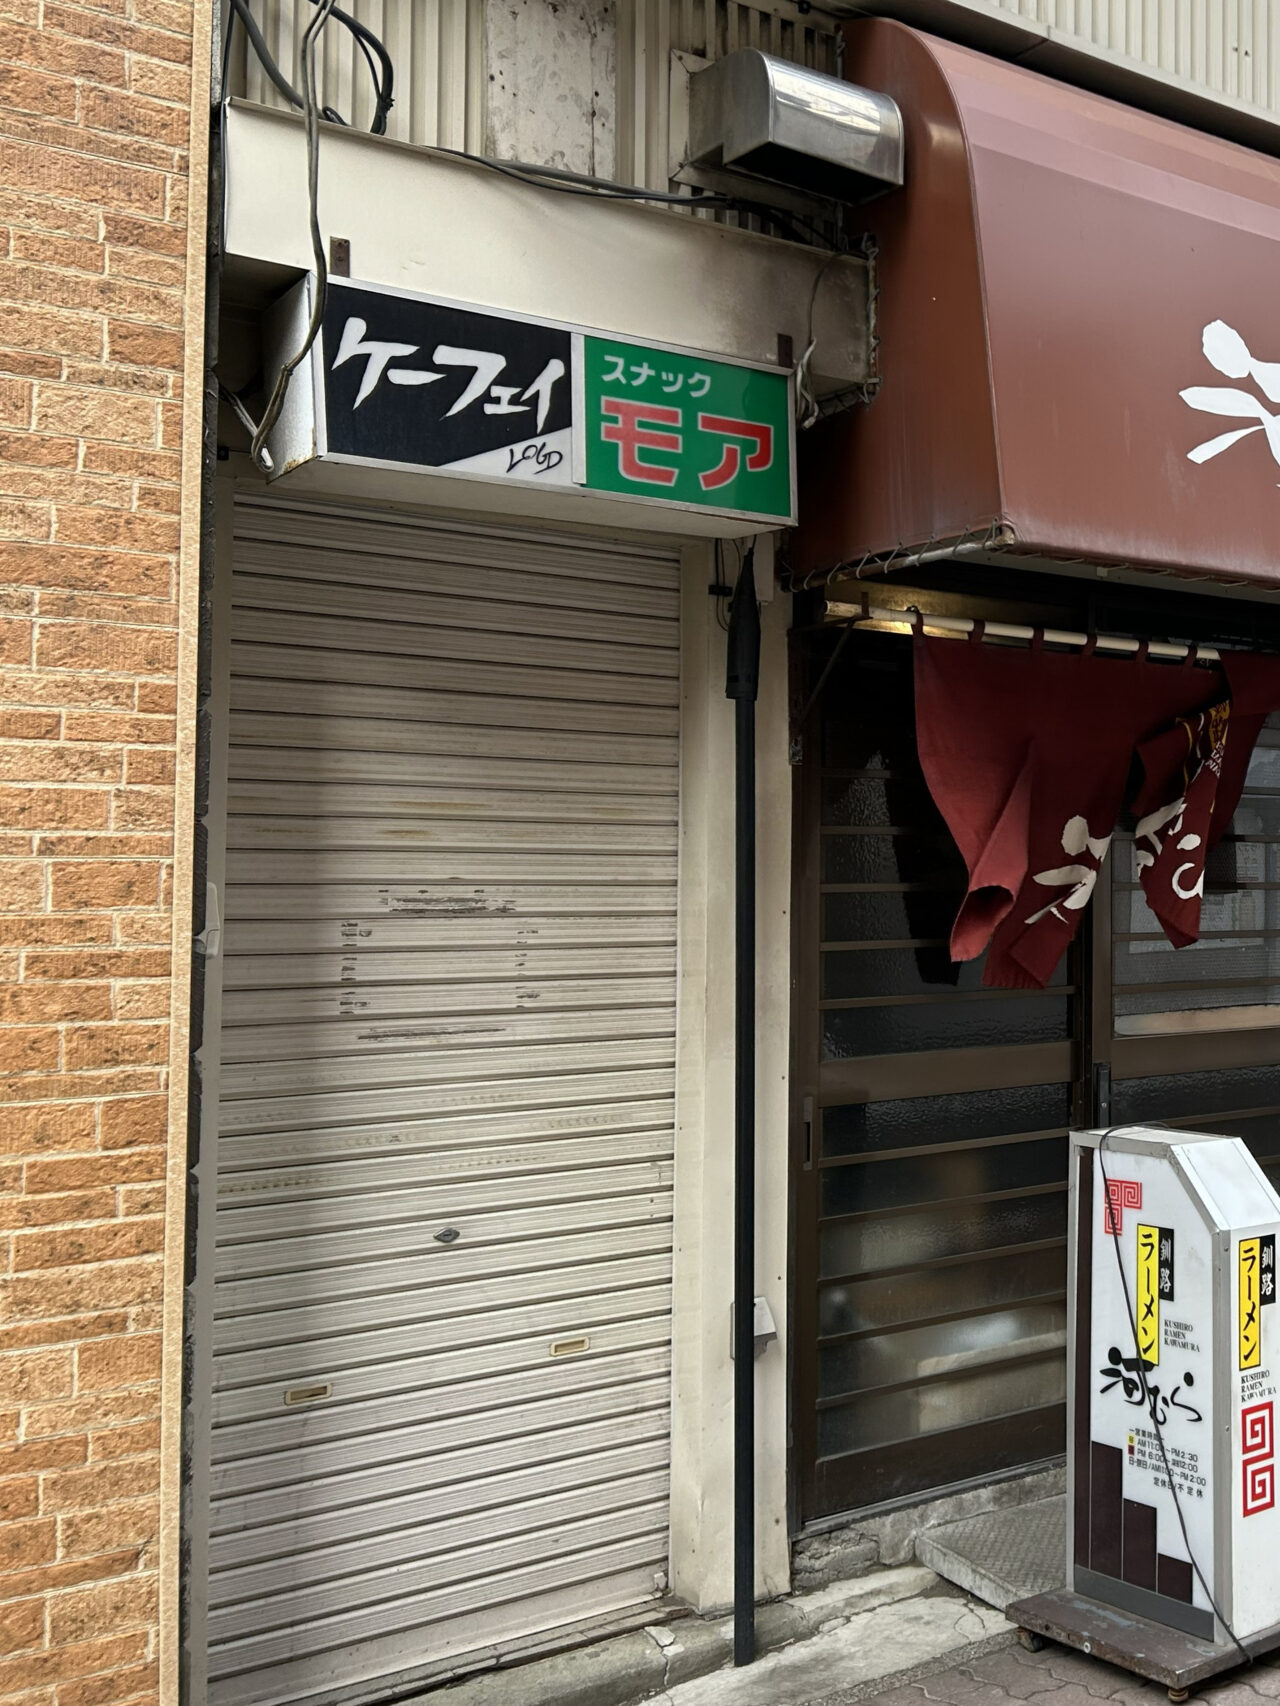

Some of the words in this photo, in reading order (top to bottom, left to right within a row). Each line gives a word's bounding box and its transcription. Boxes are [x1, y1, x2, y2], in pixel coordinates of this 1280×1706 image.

[331, 316, 565, 435] ケーフェイ
[601, 354, 712, 399] スナック
[600, 394, 775, 492] モア
[1159, 1238, 1172, 1294] 釧路
[1261, 1244, 1274, 1297] 釧路
[1140, 1232, 1156, 1356] ラーメン
[1242, 1246, 1257, 1362] ラーメン
[1164, 1319, 1193, 1332] KUSHIRO
[1164, 1329, 1187, 1340] RAMEN
[1164, 1337, 1200, 1353] KAWAMURA
[1241, 1369, 1270, 1385] KUSHIRO
[1241, 1381, 1263, 1394] RAMEN
[1241, 1386, 1277, 1403] KAWAMURA
